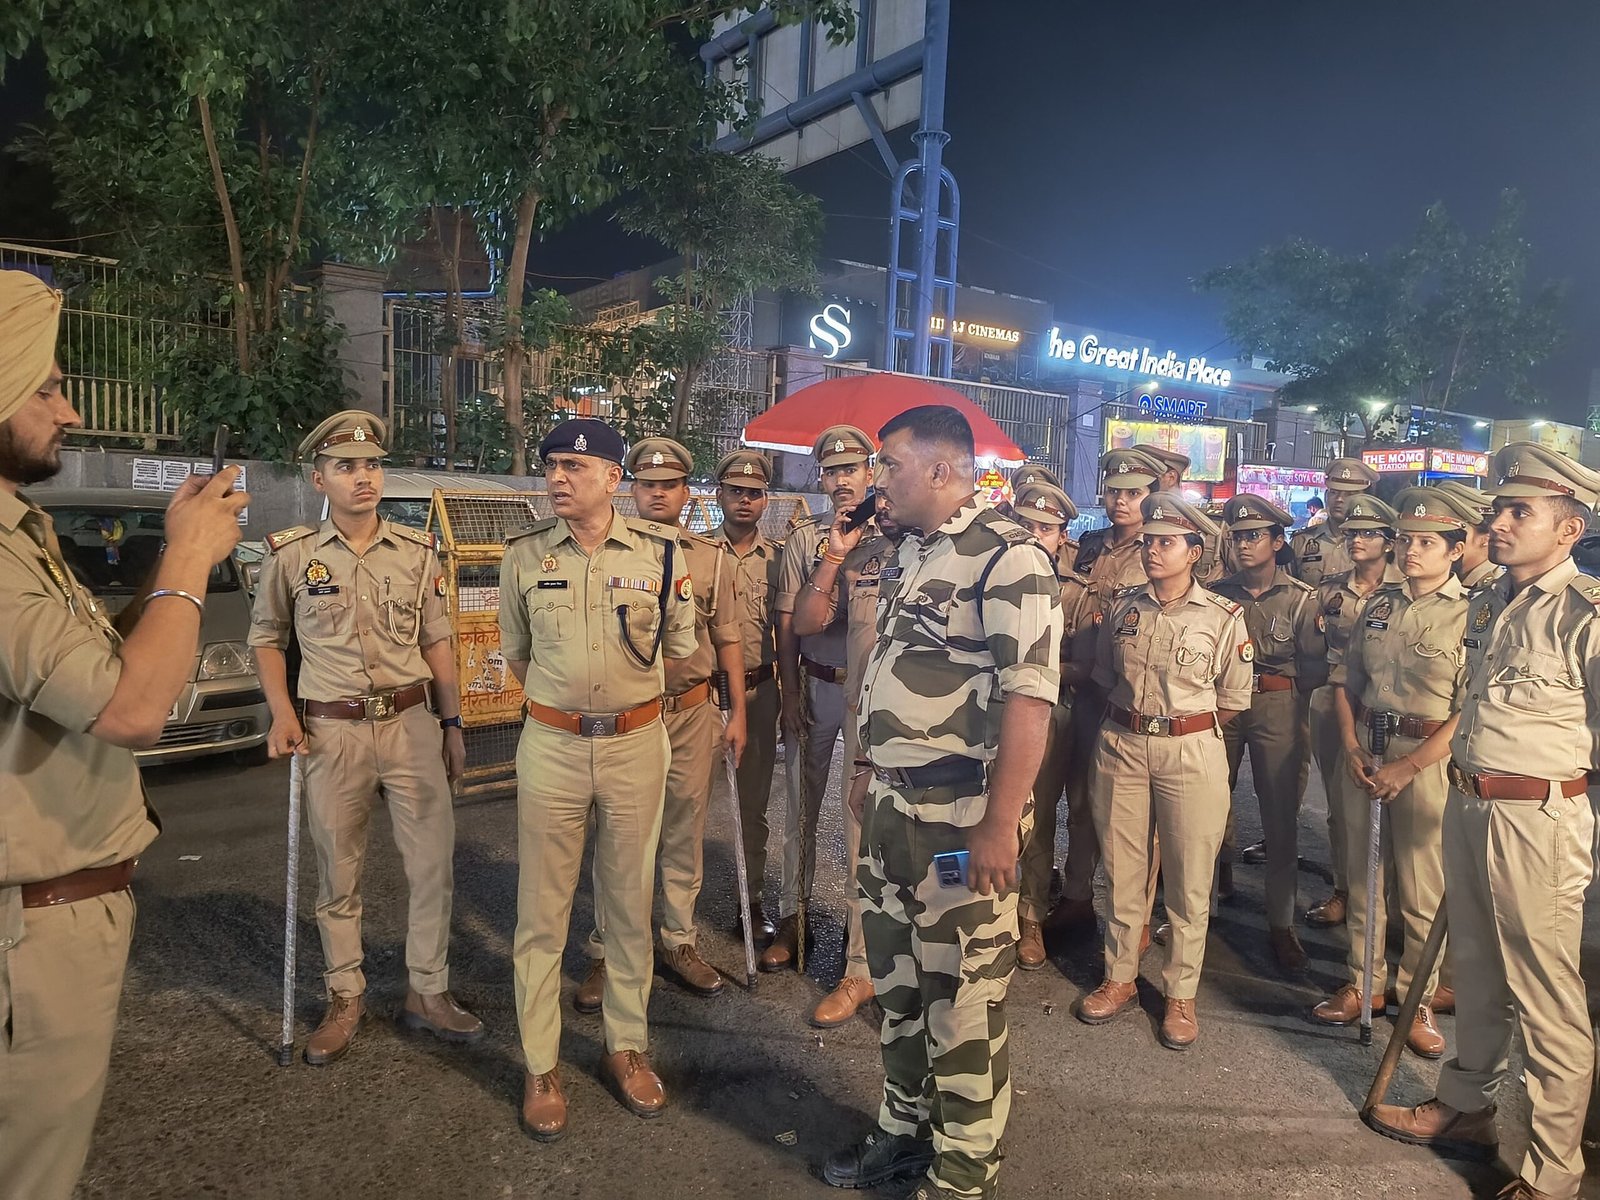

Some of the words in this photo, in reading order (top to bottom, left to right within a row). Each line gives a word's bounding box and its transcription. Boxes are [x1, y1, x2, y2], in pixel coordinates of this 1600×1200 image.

[967, 323, 1020, 343] CINEMAS
[1047, 326, 1076, 360] he
[1079, 335, 1139, 371] Great
[1139, 347, 1186, 380] India
[1185, 356, 1232, 387] Place
[1154, 395, 1208, 418] SMART
[1364, 454, 1386, 465] THE
[1388, 452, 1424, 463] MOMO
[1442, 452, 1456, 463] THE
[1456, 454, 1476, 466] MOMO
[1294, 473, 1311, 484] SOYA
[1311, 474, 1326, 485] CHA
